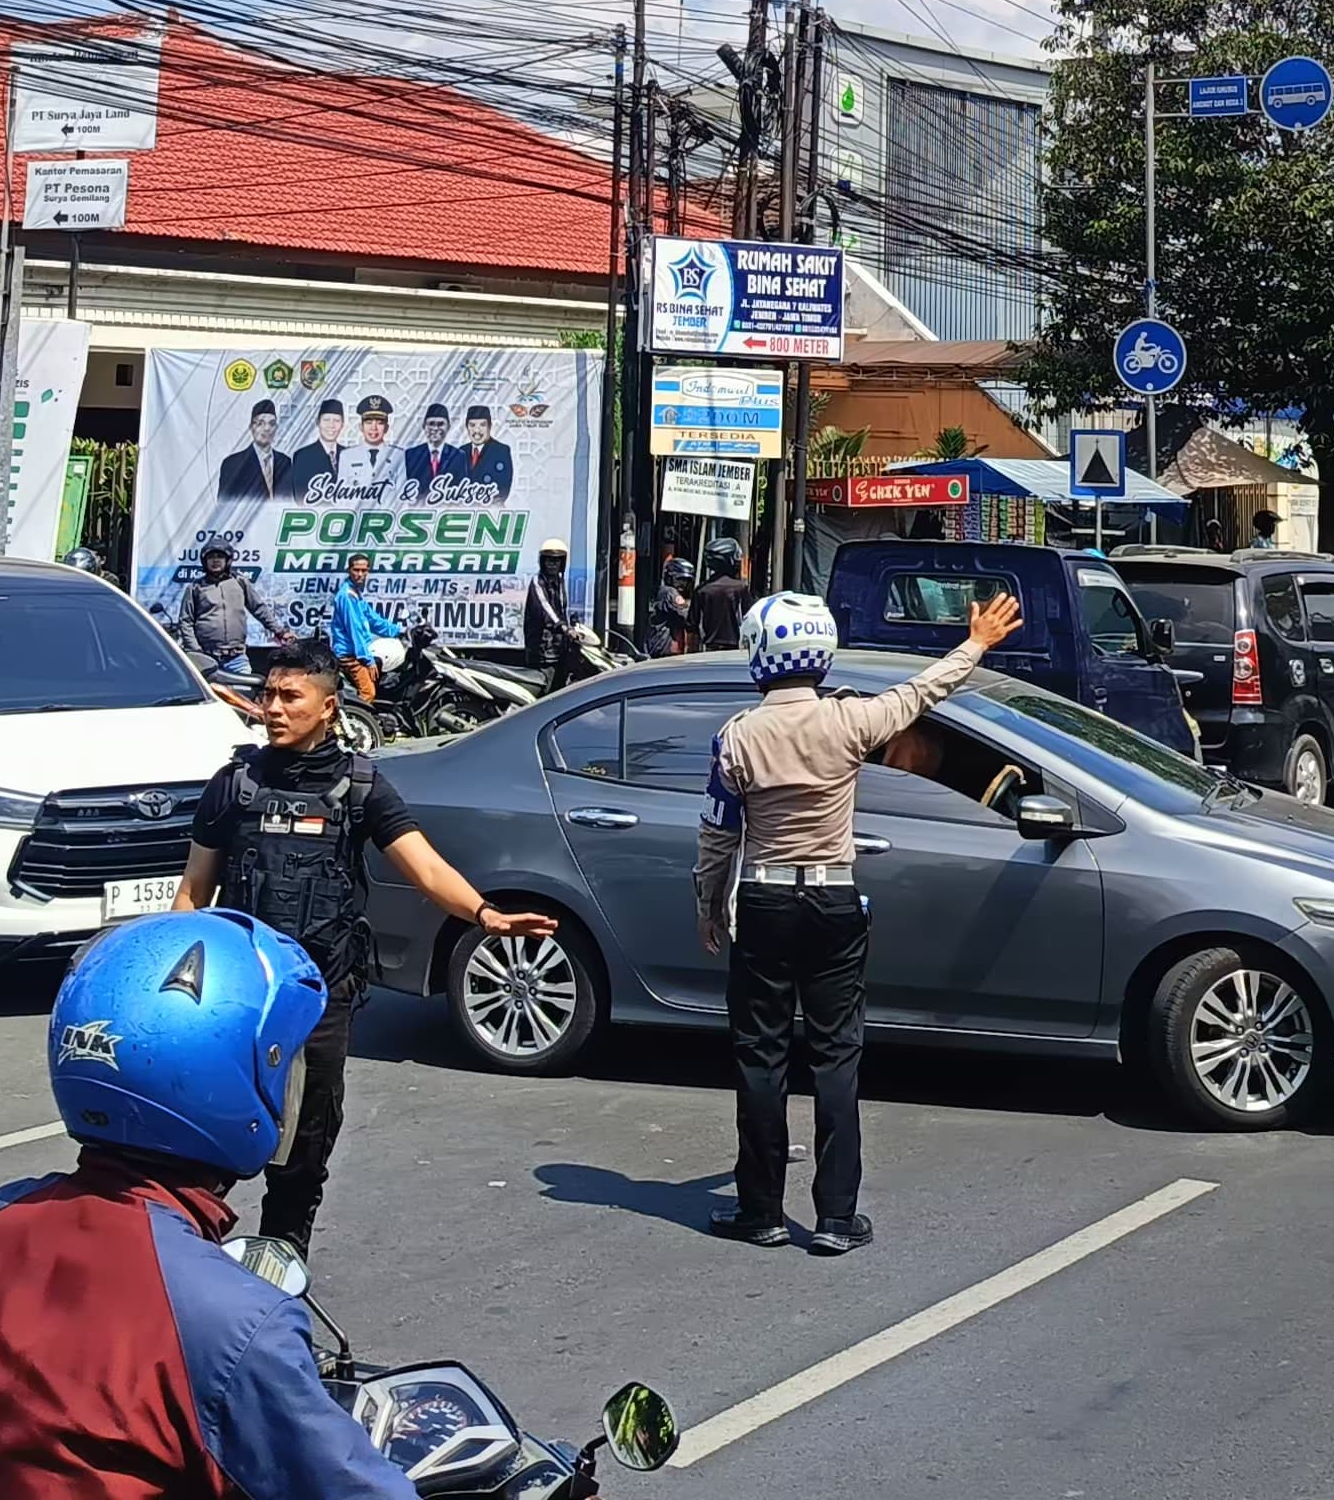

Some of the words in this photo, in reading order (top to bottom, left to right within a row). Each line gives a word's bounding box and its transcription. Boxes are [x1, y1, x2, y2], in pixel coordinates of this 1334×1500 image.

[31, 110, 44, 121] PT
[47, 110, 77, 124] Surya
[78, 109, 102, 122] Jaya
[105, 108, 131, 119] Land
[77, 125, 101, 134] 100M
[34, 167, 67, 176] Kantor
[69, 166, 123, 176] Pemasaran
[44, 183, 61, 194] PT
[64, 183, 110, 194] Pesona
[43, 194, 68, 204] Surya
[70, 194, 110, 204] Gemilang
[71, 213, 100, 223] 100M
[737, 250, 792, 274] RUMAH
[796, 254, 838, 276] SAKIT
[682, 267, 700, 286] BS
[747, 274, 781, 296] BINA
[785, 278, 827, 299] SEHAT
[656, 302, 668, 314] RS
[669, 303, 693, 315] BINA
[694, 305, 724, 317] SEHAT
[672, 315, 707, 328] JEMBER
[769, 336, 790, 352] 800
[793, 338, 829, 355] METER
[678, 430, 756, 441] TERSEDIA
[668, 458, 688, 474] SMA
[689, 460, 716, 477] ISLAM
[717, 463, 751, 481] JEMBER
[305, 473, 394, 504] Selamat
[399, 480, 420, 501] &
[426, 473, 500, 505] Sukses
[675, 476, 731, 491] TERAKREDITASI
[277, 510, 529, 547] PORSENI
[283, 552, 512, 572] MARASAH
[292, 577, 380, 595] JENJG
[384, 578, 407, 595] MI
[422, 579, 459, 595] MTs
[475, 579, 503, 595] MA
[111, 885, 121, 905] P
[132, 880, 175, 903] 1538
[62, 1027, 115, 1056] INK
